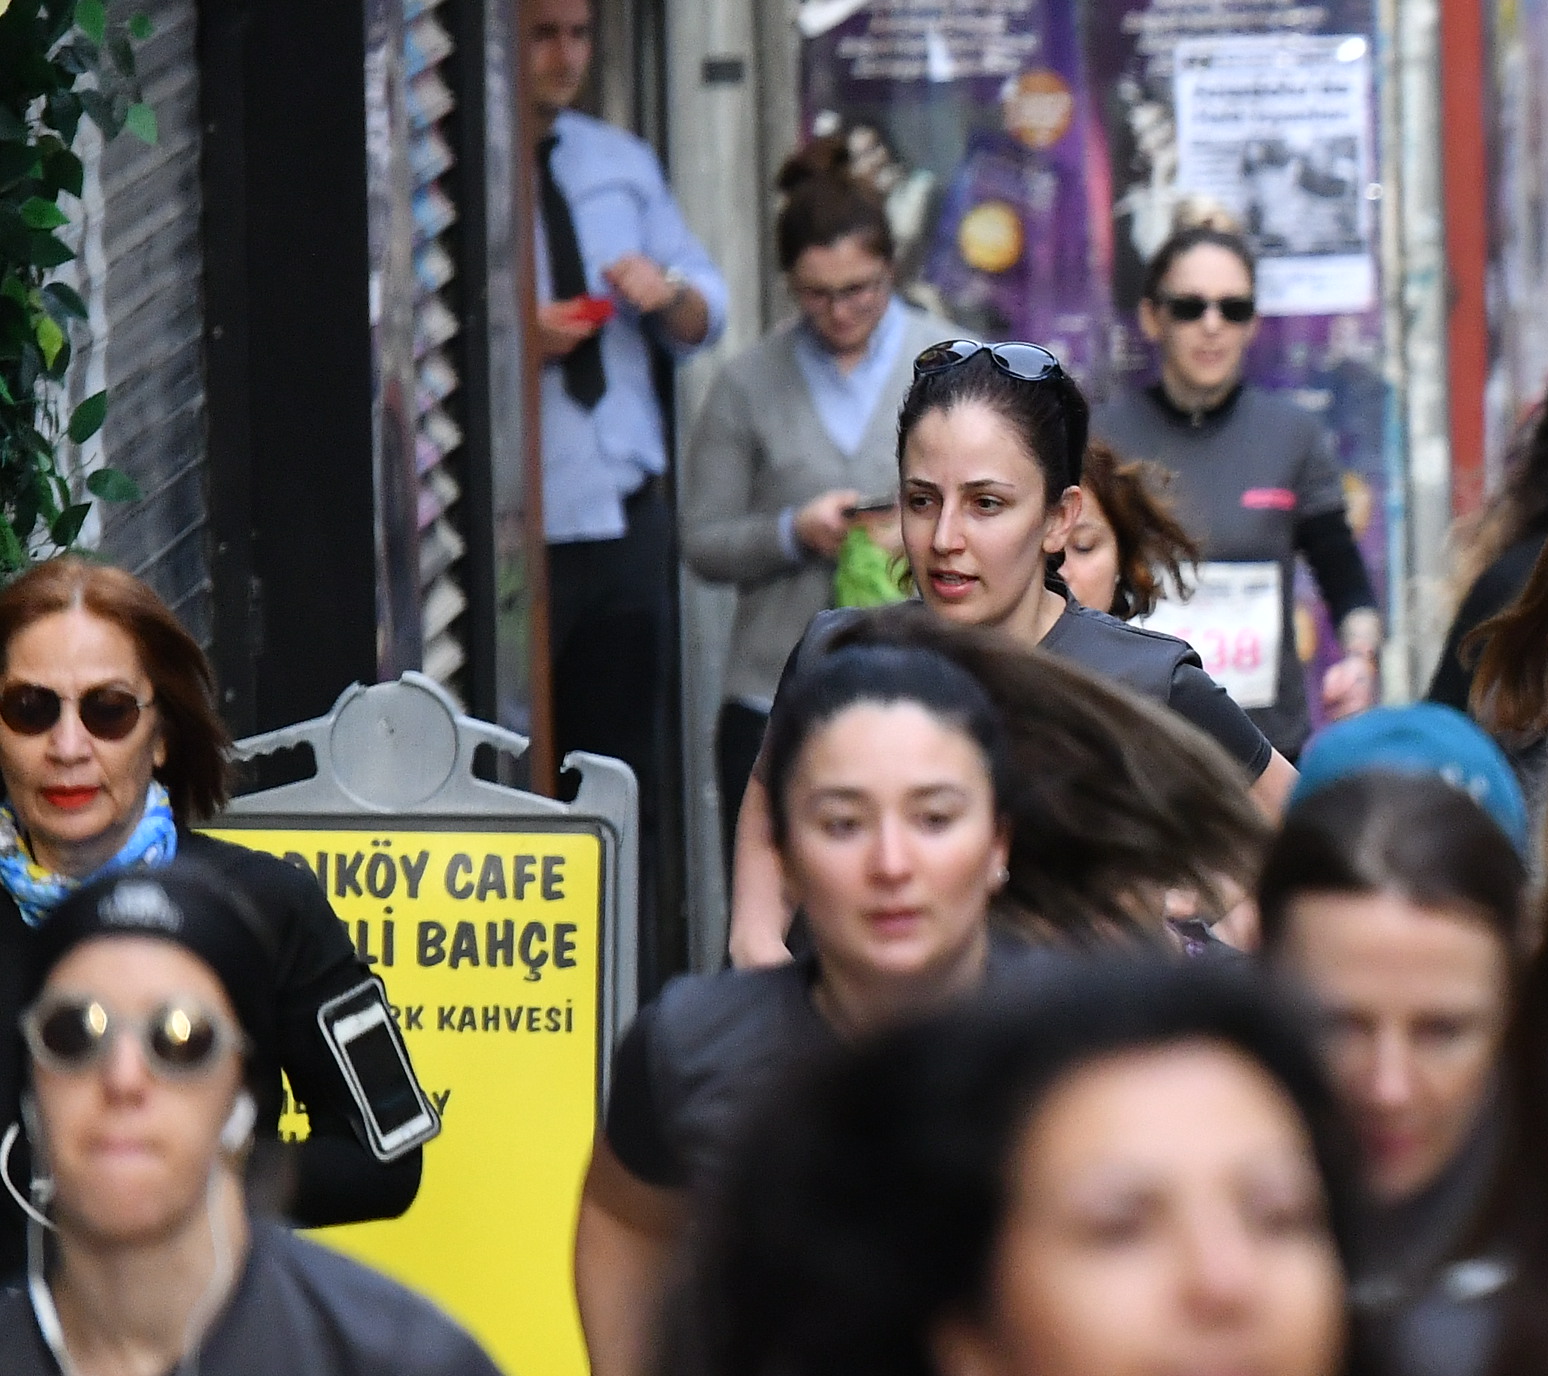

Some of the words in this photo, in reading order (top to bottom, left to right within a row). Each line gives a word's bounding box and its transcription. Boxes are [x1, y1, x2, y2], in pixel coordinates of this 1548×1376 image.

[1176, 627, 1263, 675] 38
[444, 852, 566, 902] CAFE
[416, 919, 577, 981] BAHÇE
[390, 1005, 424, 1031] RK
[437, 998, 573, 1033] KAHVESİ
